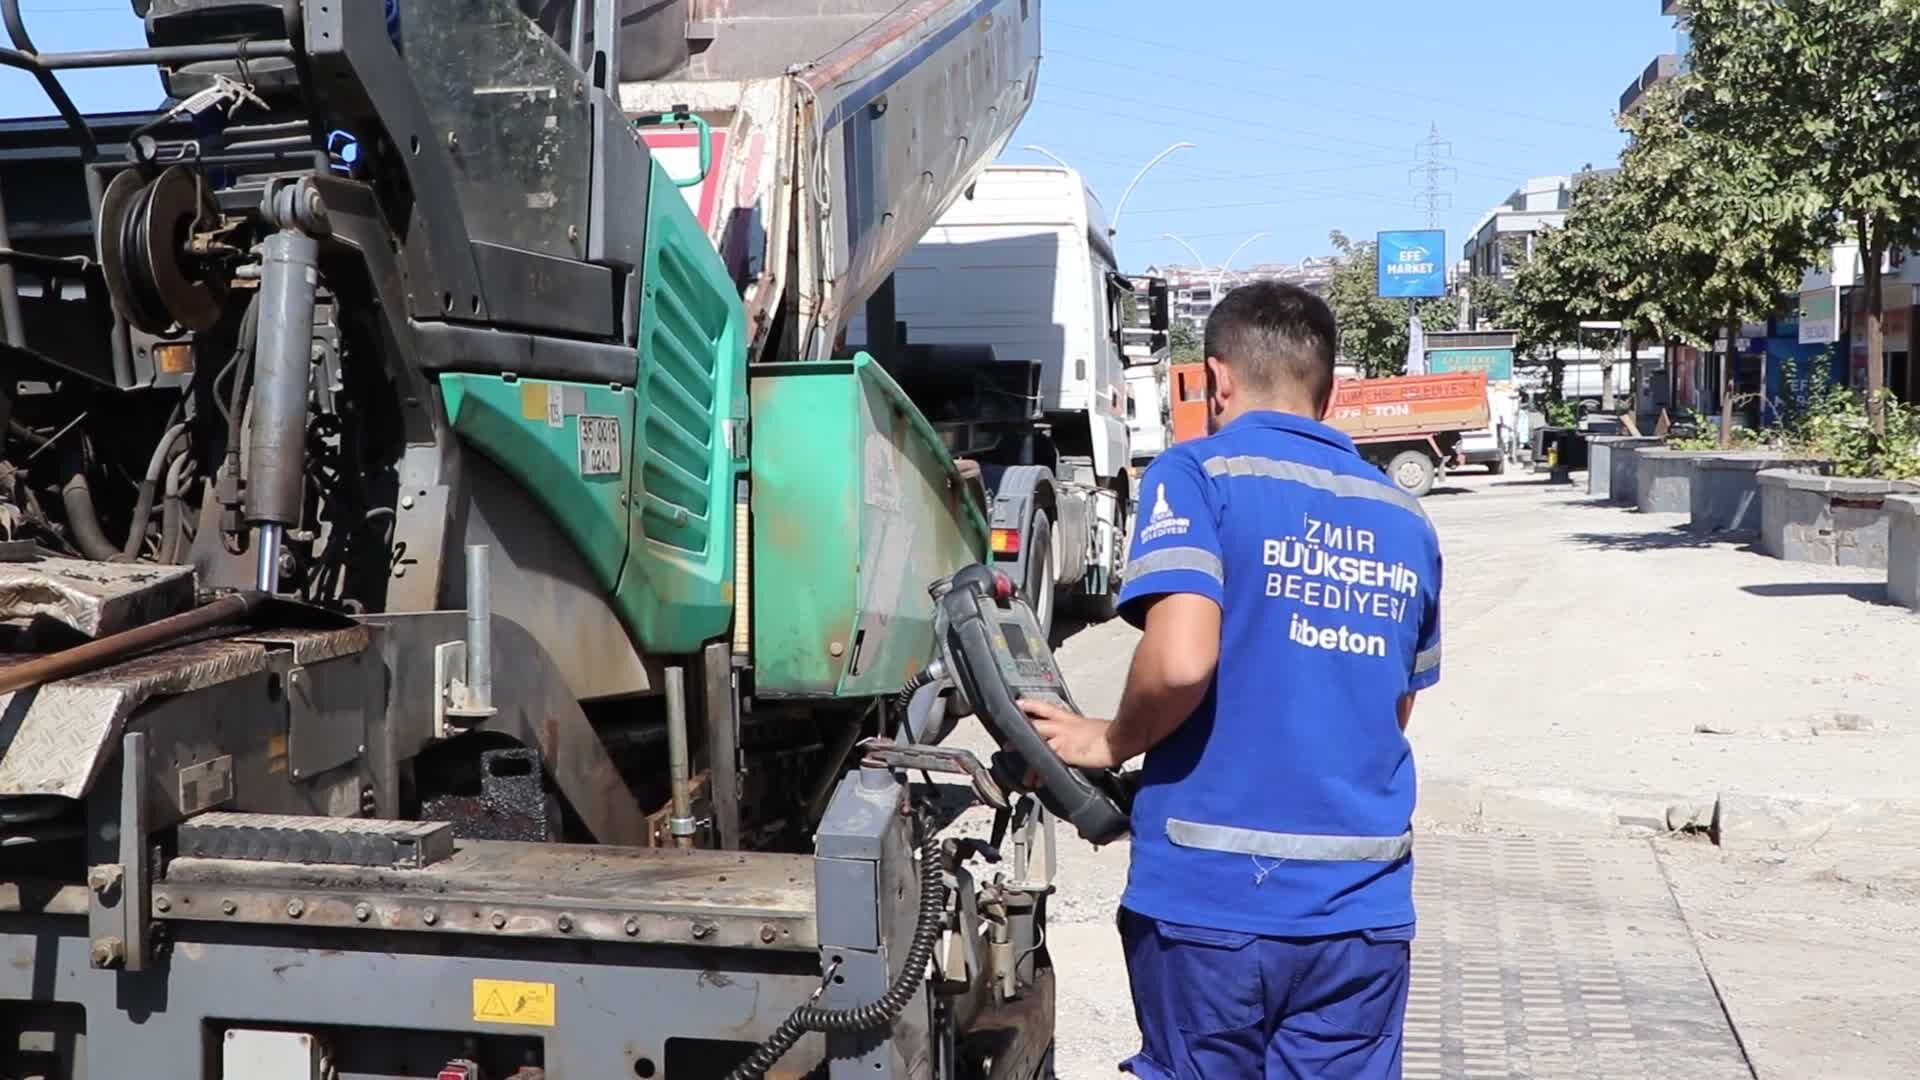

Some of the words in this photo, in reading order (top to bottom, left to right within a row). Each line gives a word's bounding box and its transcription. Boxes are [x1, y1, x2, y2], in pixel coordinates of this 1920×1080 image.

[1399, 250, 1422, 262] EFE
[1386, 262, 1434, 275] MARKET
[1303, 511, 1375, 554] İZMİR
